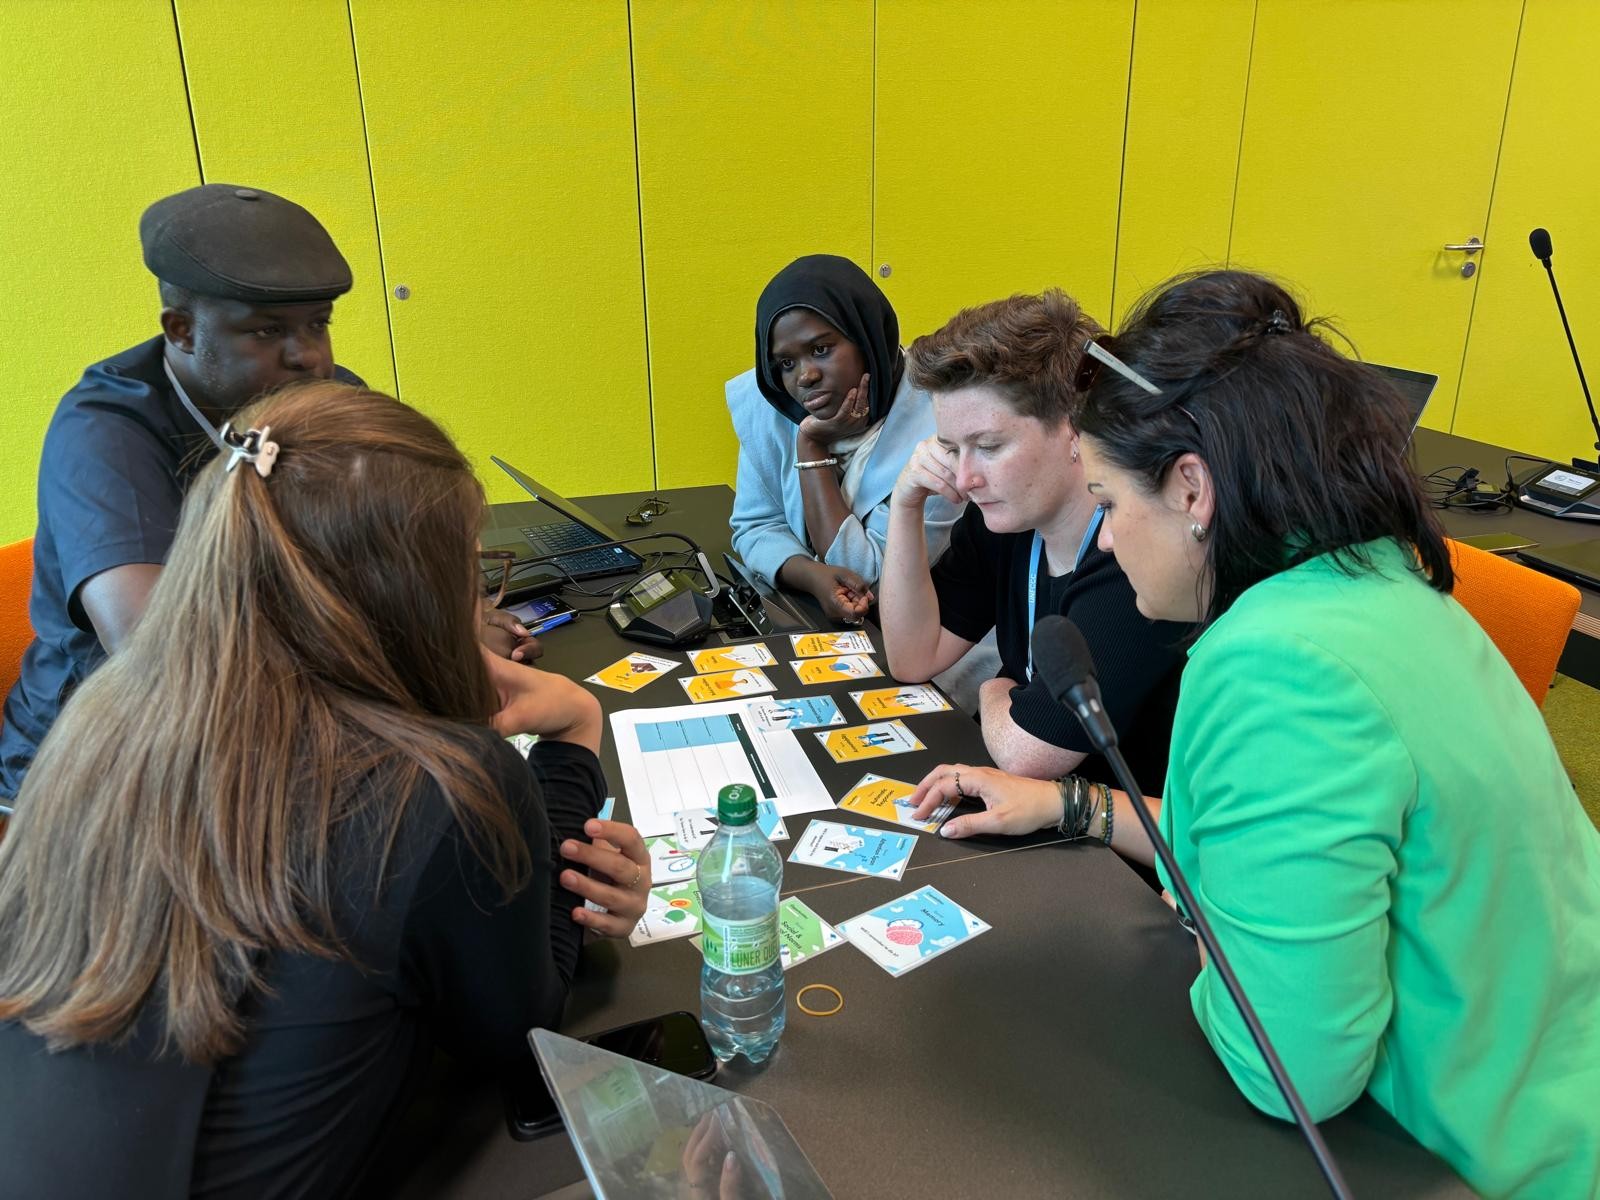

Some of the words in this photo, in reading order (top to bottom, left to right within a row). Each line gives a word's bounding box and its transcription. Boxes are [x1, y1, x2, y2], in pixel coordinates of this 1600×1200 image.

[870, 788, 888, 804] Automatic
[877, 789, 895, 807] Responses
[873, 838, 887, 856] Attention
[868, 854, 880, 866] Span
[920, 908, 944, 927] Memory
[782, 920, 798, 936] Social
[785, 933, 802, 950] Norms
